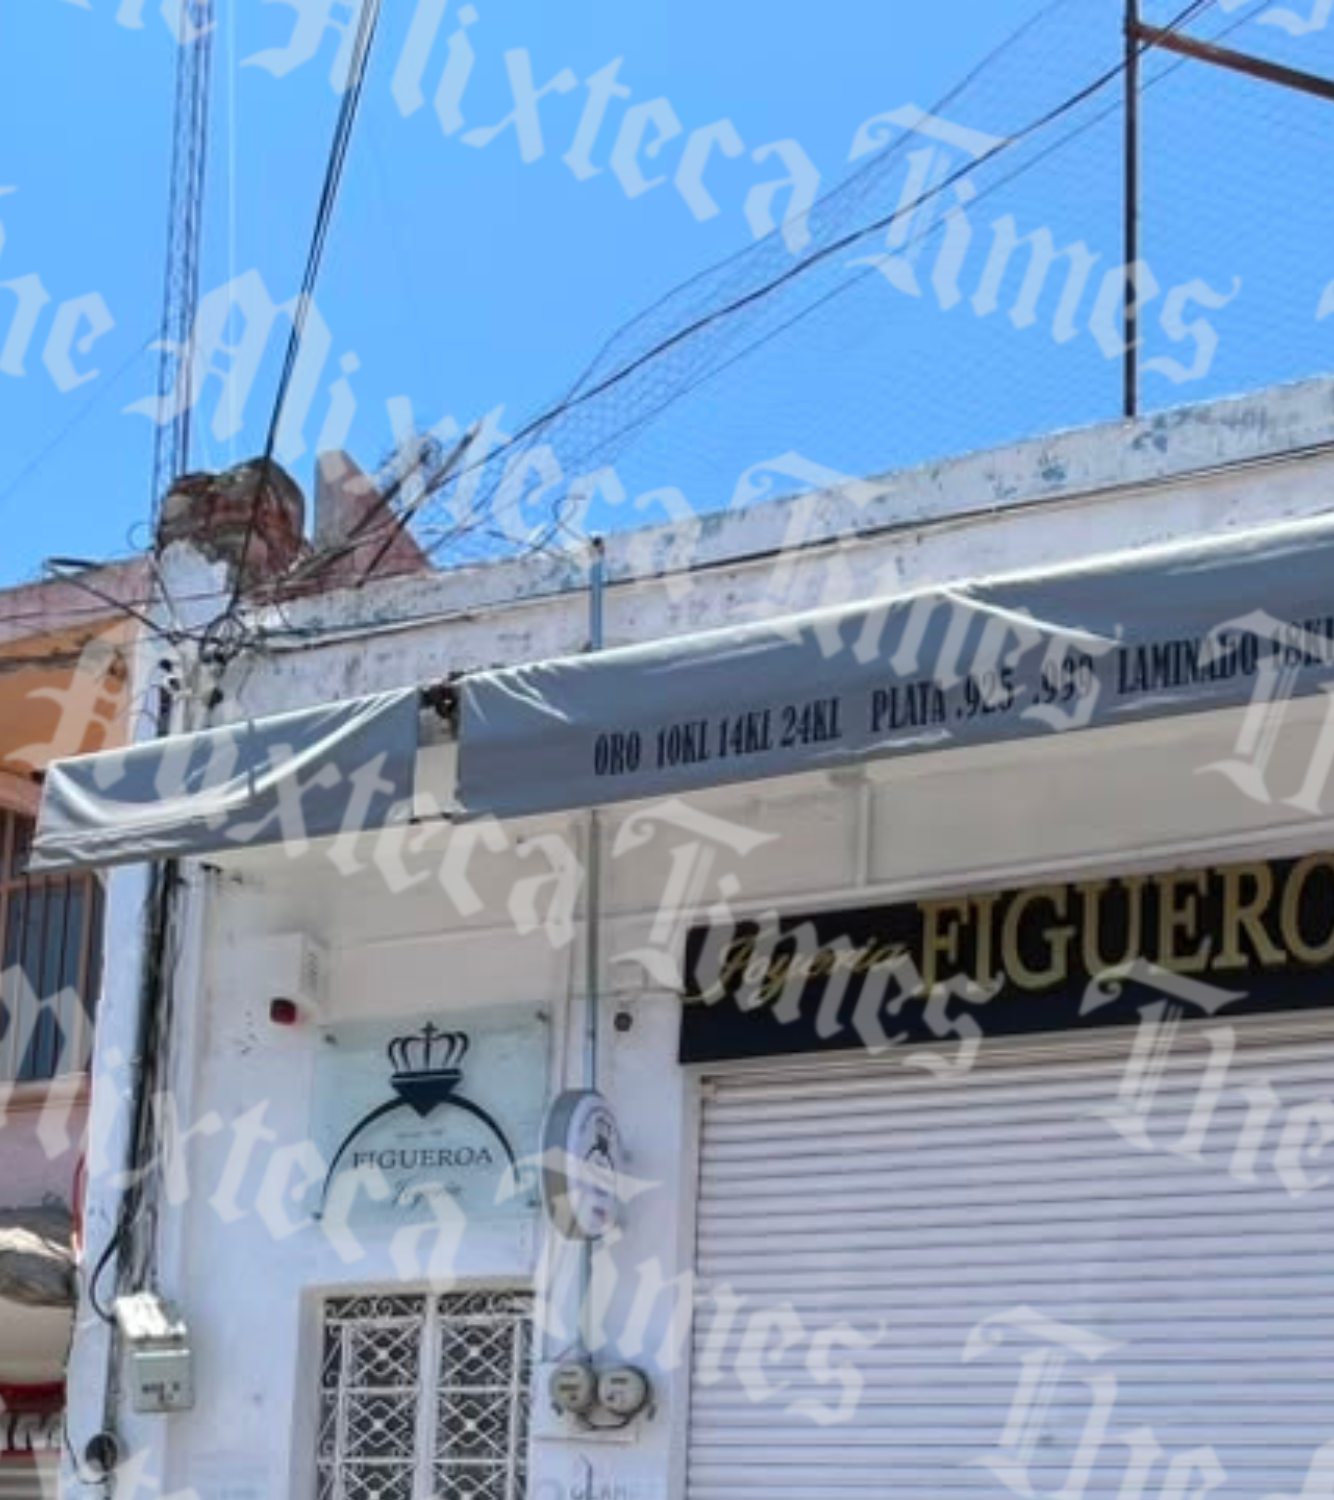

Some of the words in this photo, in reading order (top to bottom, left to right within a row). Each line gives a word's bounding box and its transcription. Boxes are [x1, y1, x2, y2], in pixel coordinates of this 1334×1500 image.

[594, 730, 642, 776] ORO
[870, 679, 946, 733] PLATA
[1116, 630, 1259, 695] LAMINADO
[352, 1146, 494, 1170] FIGUEROA
